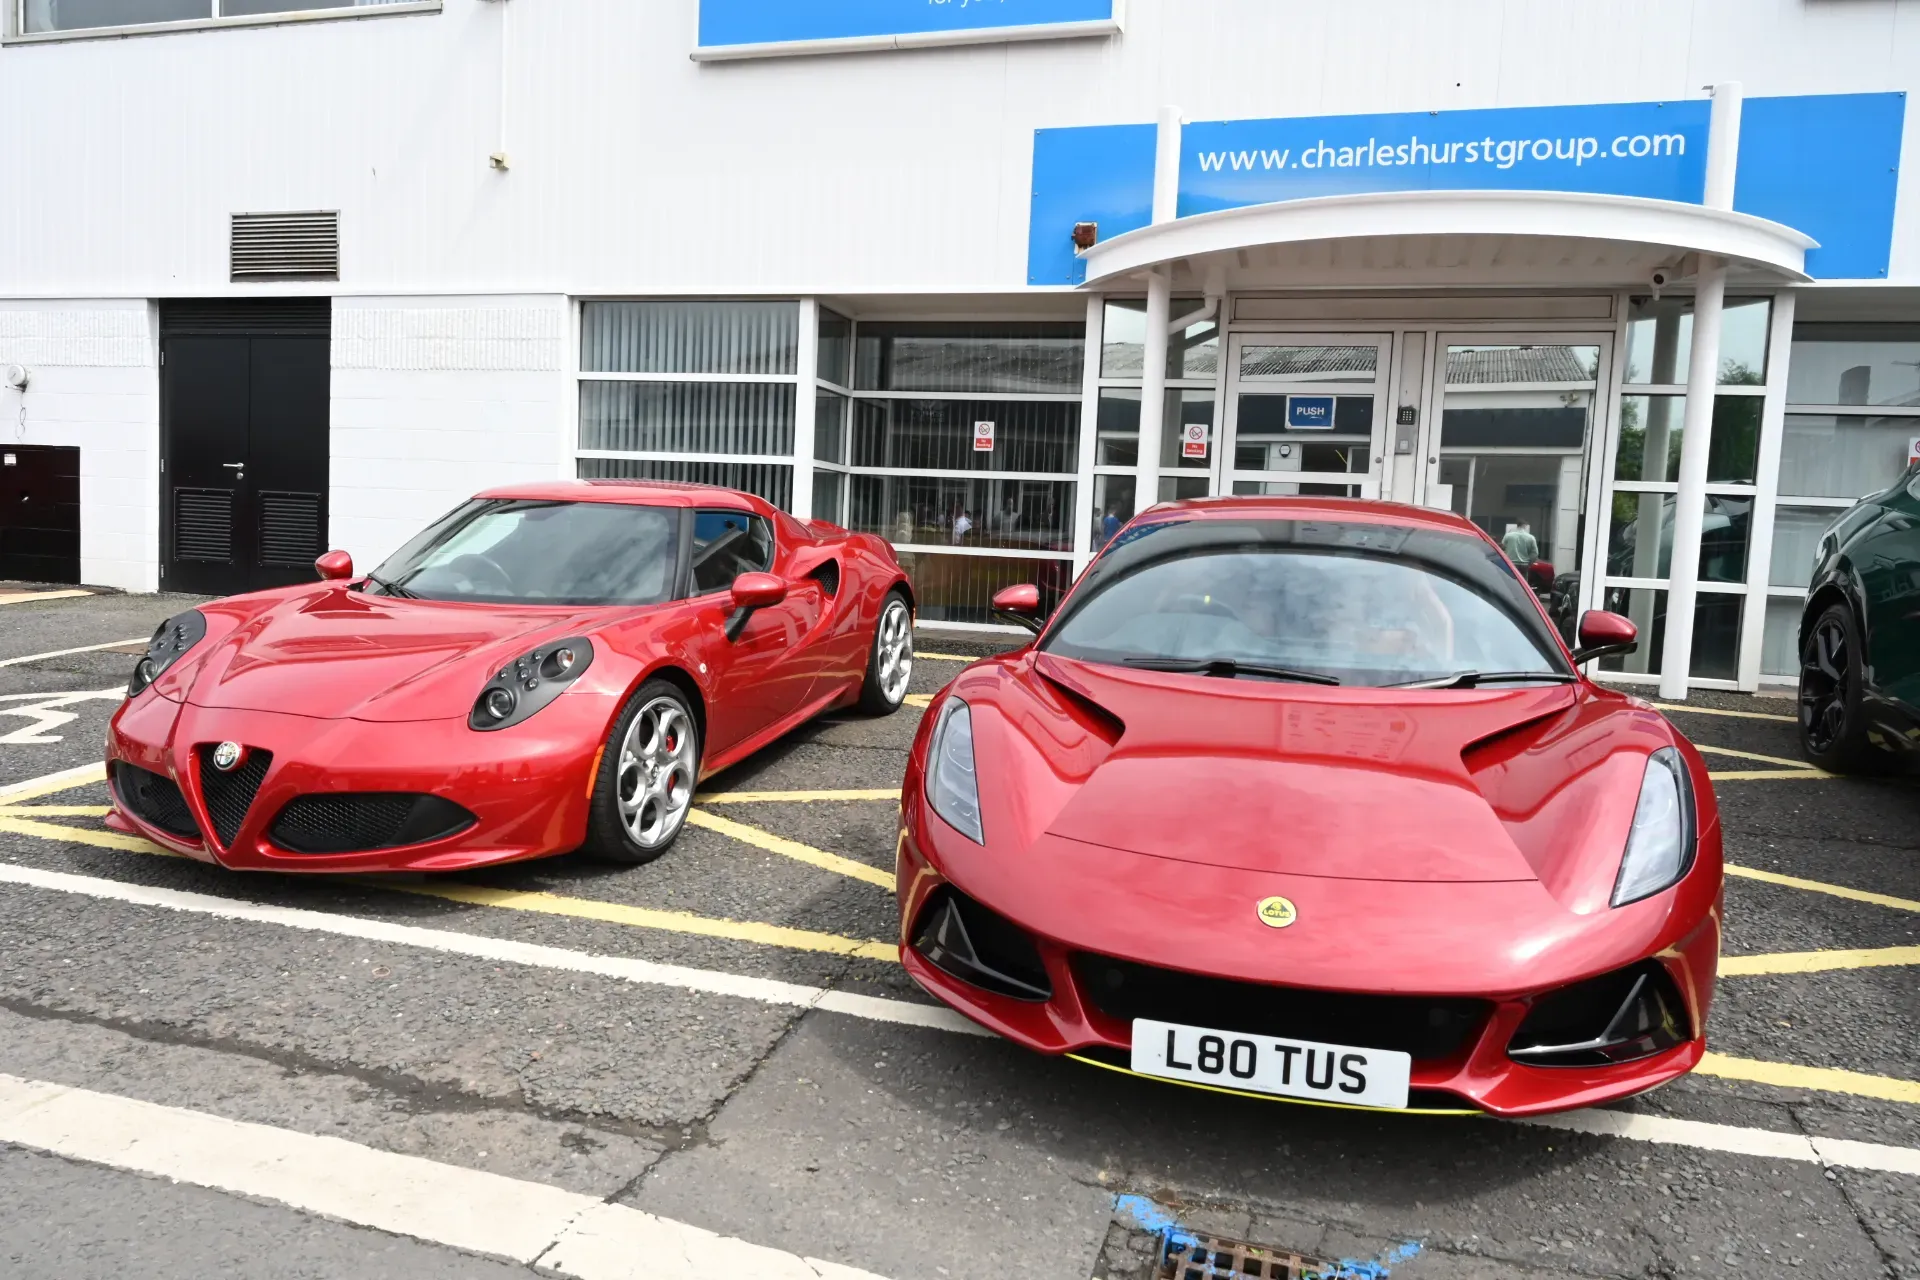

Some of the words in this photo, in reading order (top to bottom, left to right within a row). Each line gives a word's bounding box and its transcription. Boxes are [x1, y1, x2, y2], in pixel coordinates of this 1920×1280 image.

[1198, 132, 1686, 172] www.charleshurstgroup.com
[1296, 407, 1325, 416] PUSH
[1275, 1045, 1368, 1094] TUS
